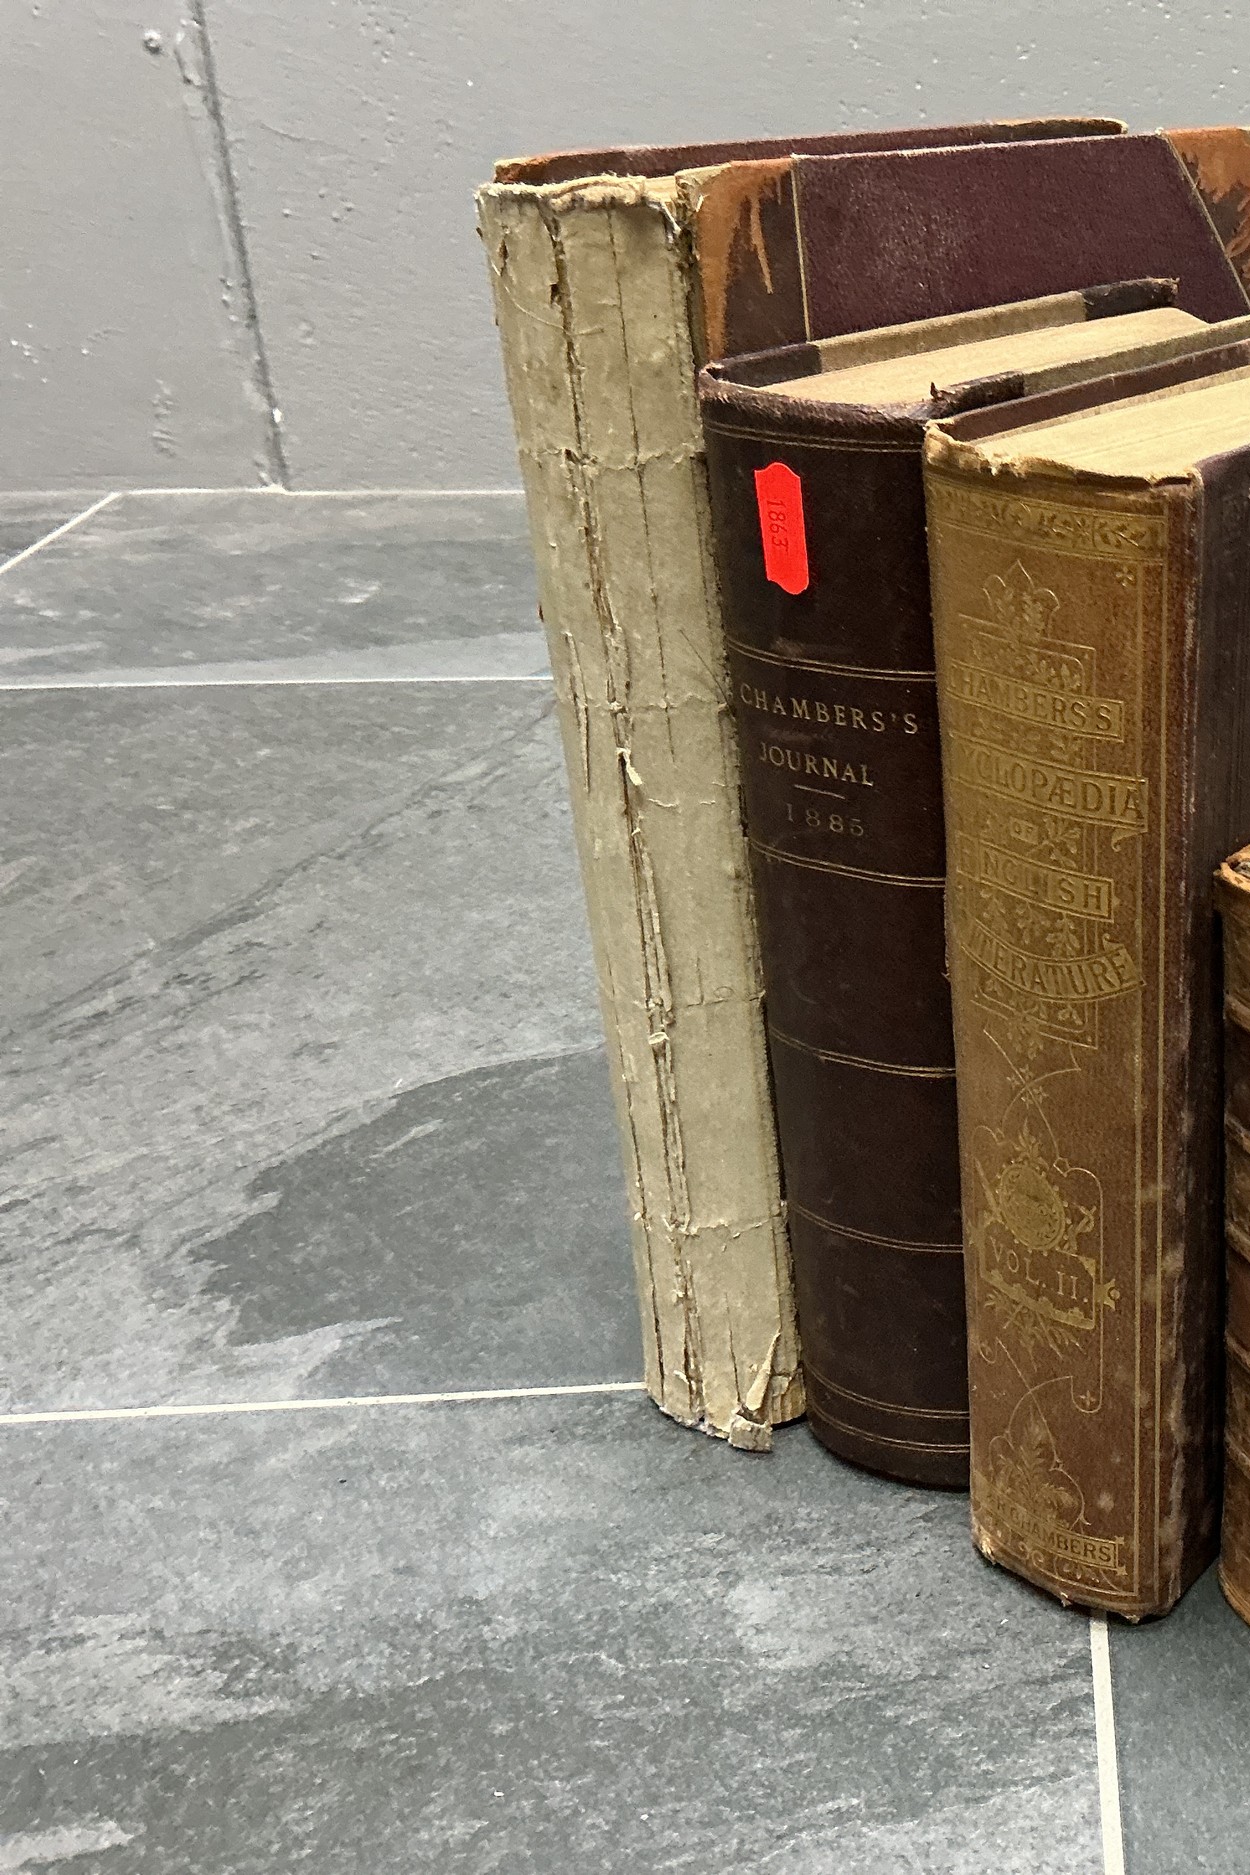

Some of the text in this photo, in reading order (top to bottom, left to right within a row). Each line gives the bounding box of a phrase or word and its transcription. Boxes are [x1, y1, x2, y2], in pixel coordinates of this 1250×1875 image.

[766, 499, 789, 555] 1863
[740, 683, 919, 734] CHAMBERS'S
[760, 742, 874, 787] JOURNAL
[953, 742, 1144, 819] YCLOPÆDIA
[785, 803, 864, 836] 1885
[959, 838, 1101, 911] ENGLISH
[990, 1238, 1047, 1288] VOL.
